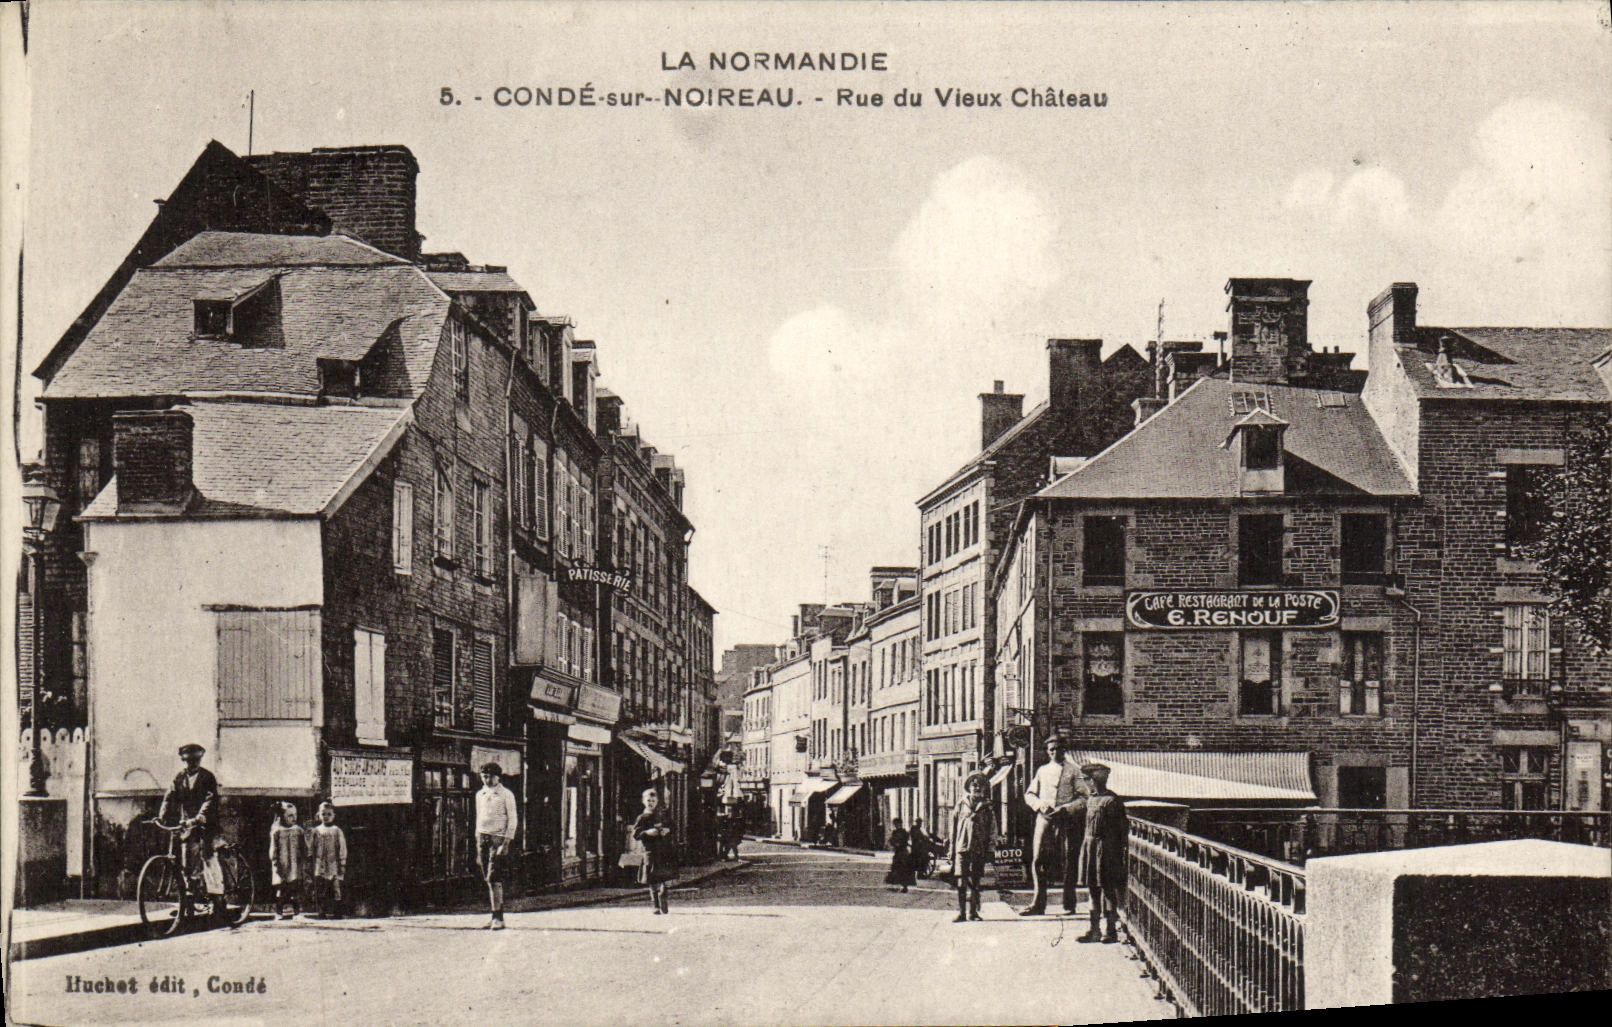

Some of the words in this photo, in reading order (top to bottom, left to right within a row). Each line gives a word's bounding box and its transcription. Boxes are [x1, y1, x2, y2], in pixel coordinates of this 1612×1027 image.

[1178, 594, 1249, 609] RESTAURANT
[1252, 596, 1264, 608] DE
[1268, 596, 1280, 608] LA
[1284, 593, 1322, 609] POSTE
[994, 848, 1023, 859] MOTO
